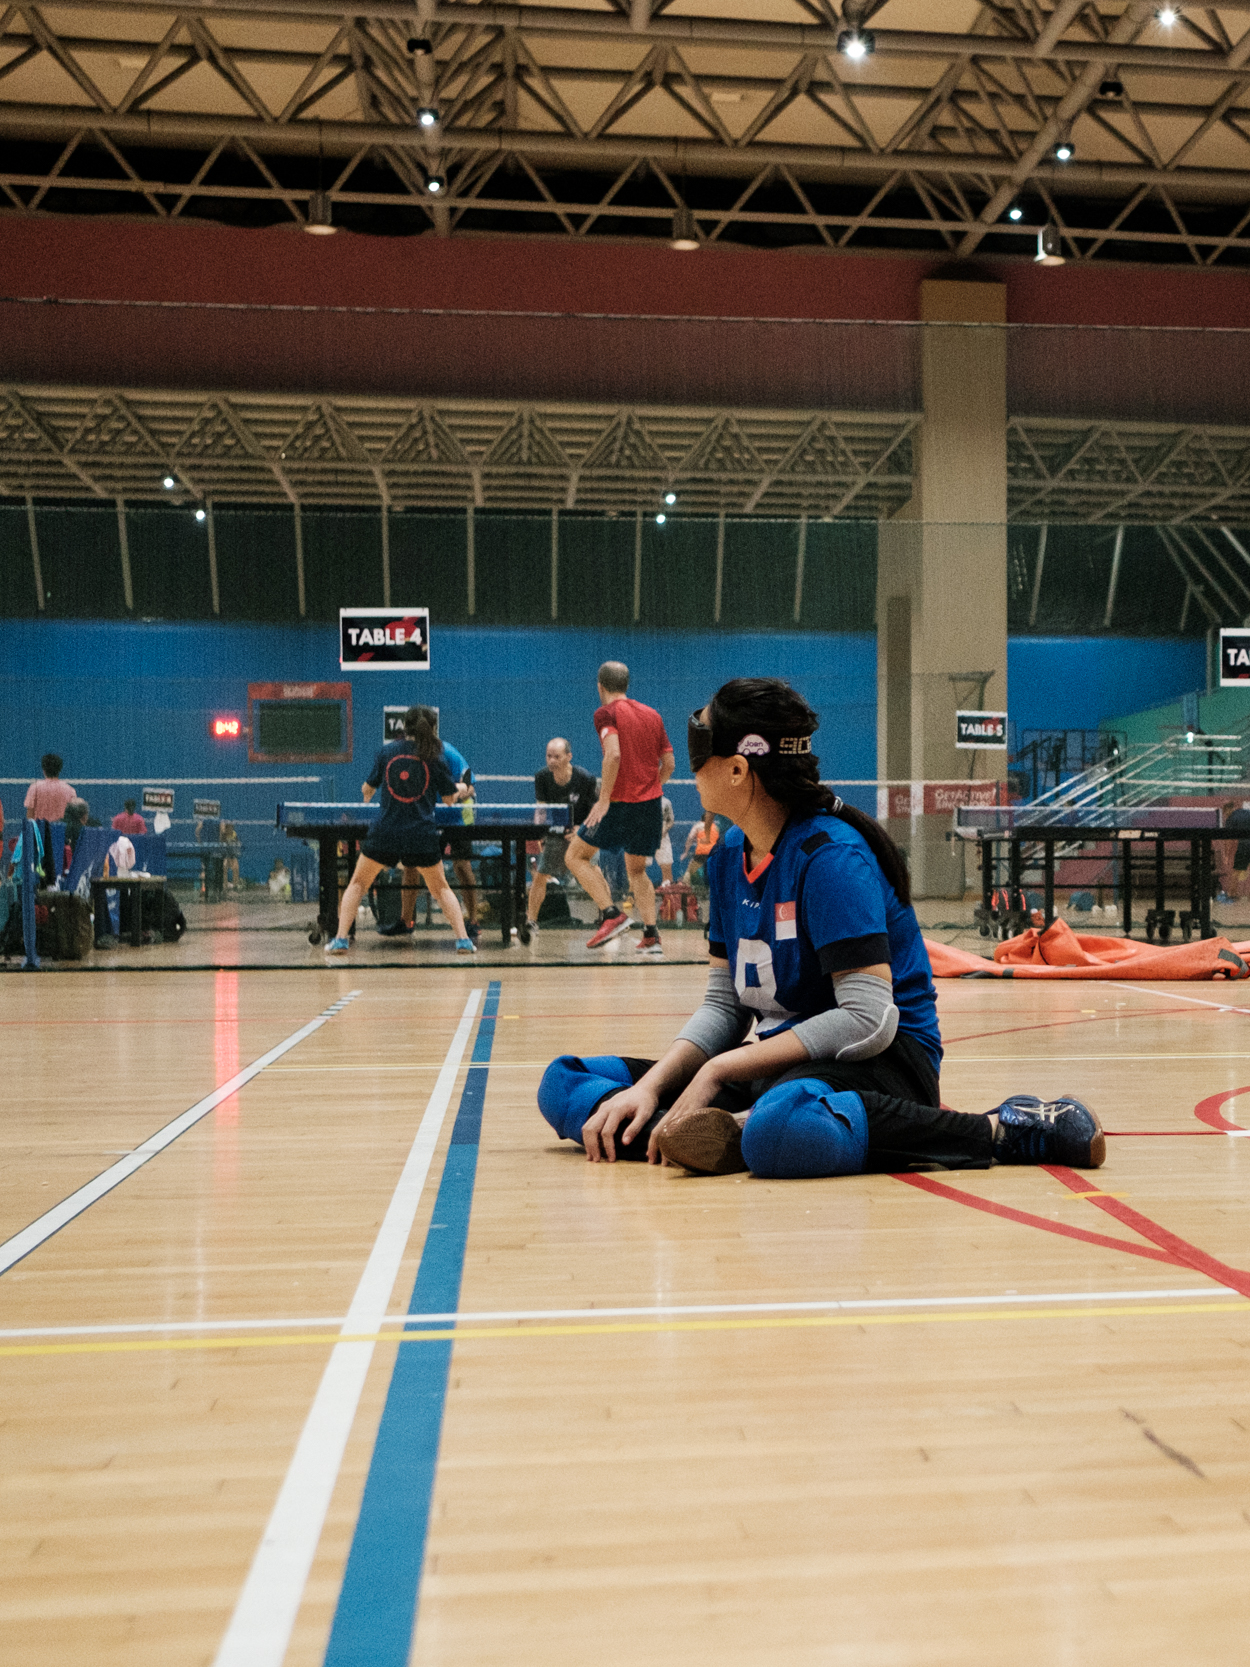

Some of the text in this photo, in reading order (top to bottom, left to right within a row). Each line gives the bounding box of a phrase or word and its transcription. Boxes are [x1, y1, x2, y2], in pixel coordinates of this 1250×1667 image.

[347, 627, 423, 646] TABLE 4
[960, 723, 994, 736] TABLE
